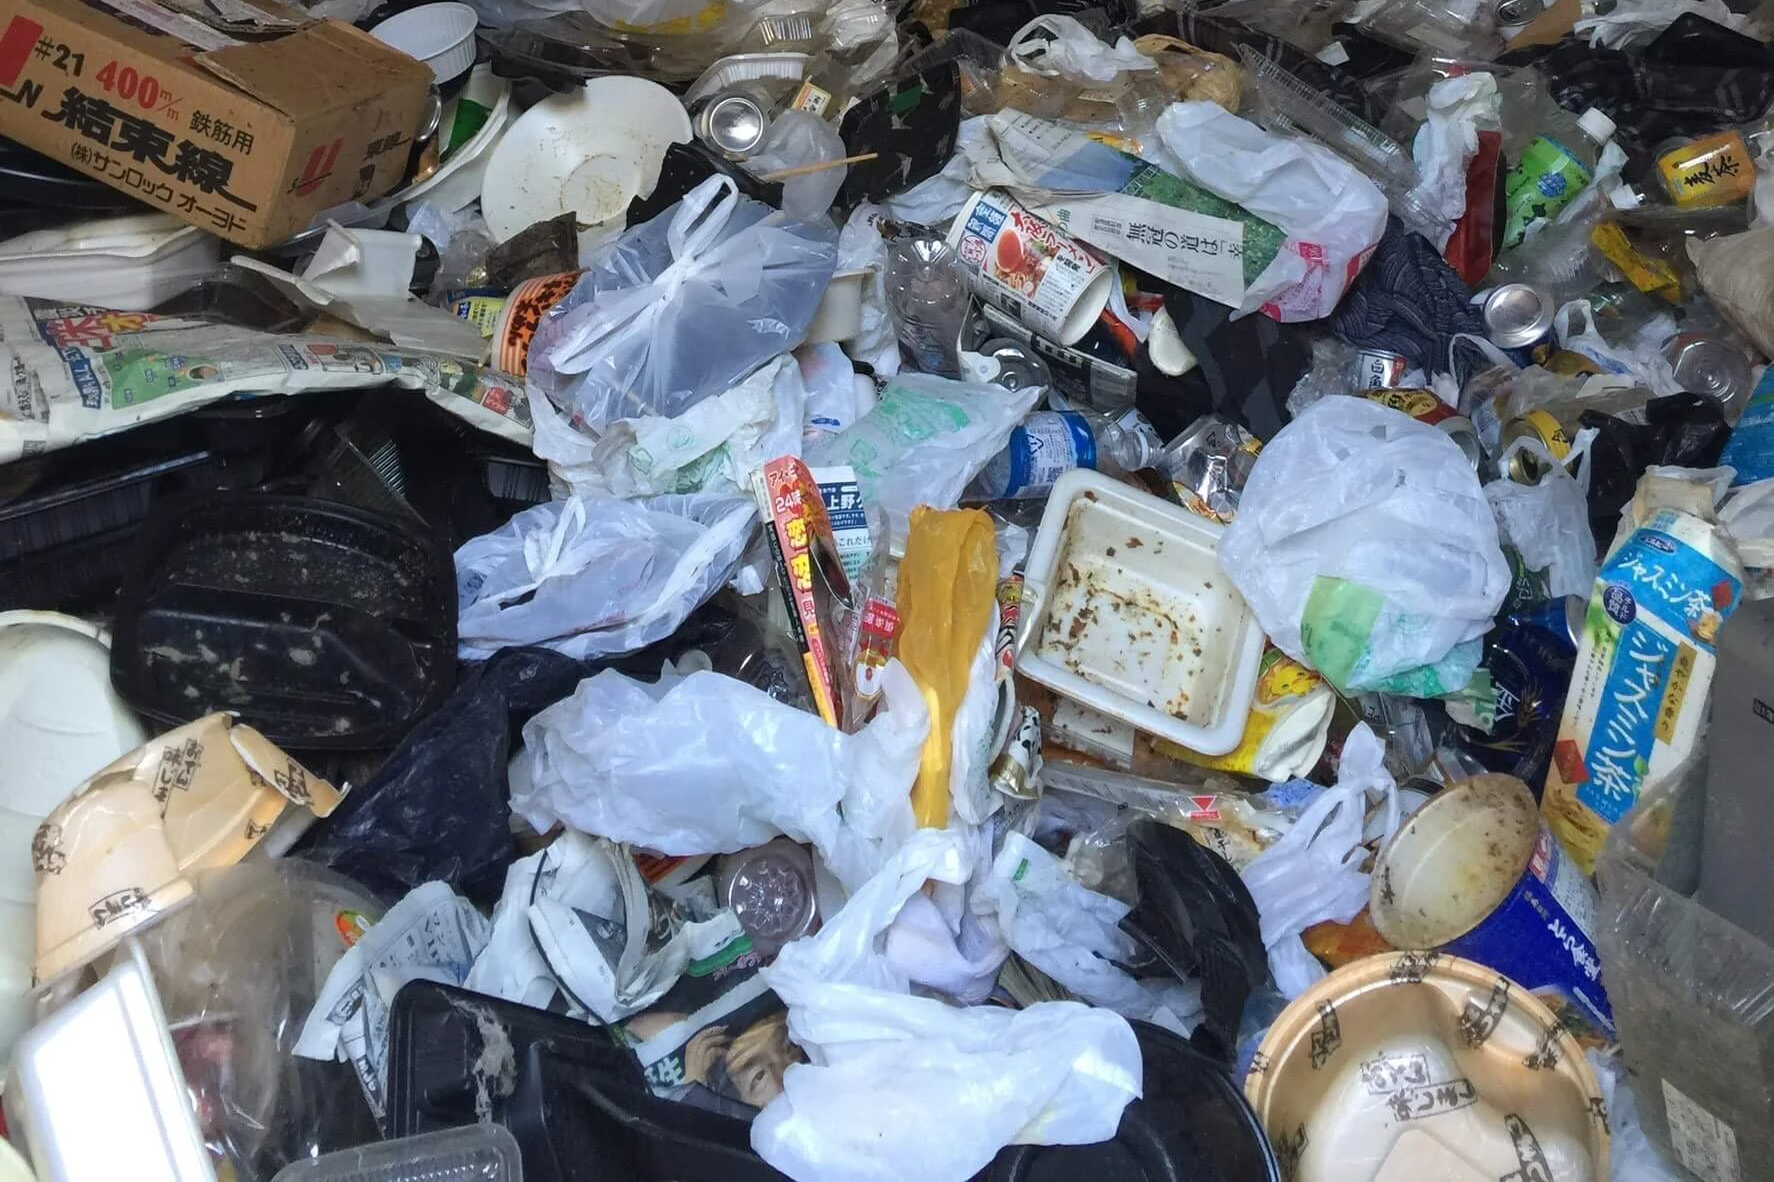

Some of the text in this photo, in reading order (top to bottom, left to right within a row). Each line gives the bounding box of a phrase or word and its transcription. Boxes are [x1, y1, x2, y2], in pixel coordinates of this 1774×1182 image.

[41, 85, 258, 213] 結束線
[189, 109, 255, 156] 鉄筋用
[1617, 551, 1712, 619] ジャスミン茶
[1591, 630, 1670, 802] ジャスミン茶
[154, 746, 183, 819] 味じま
